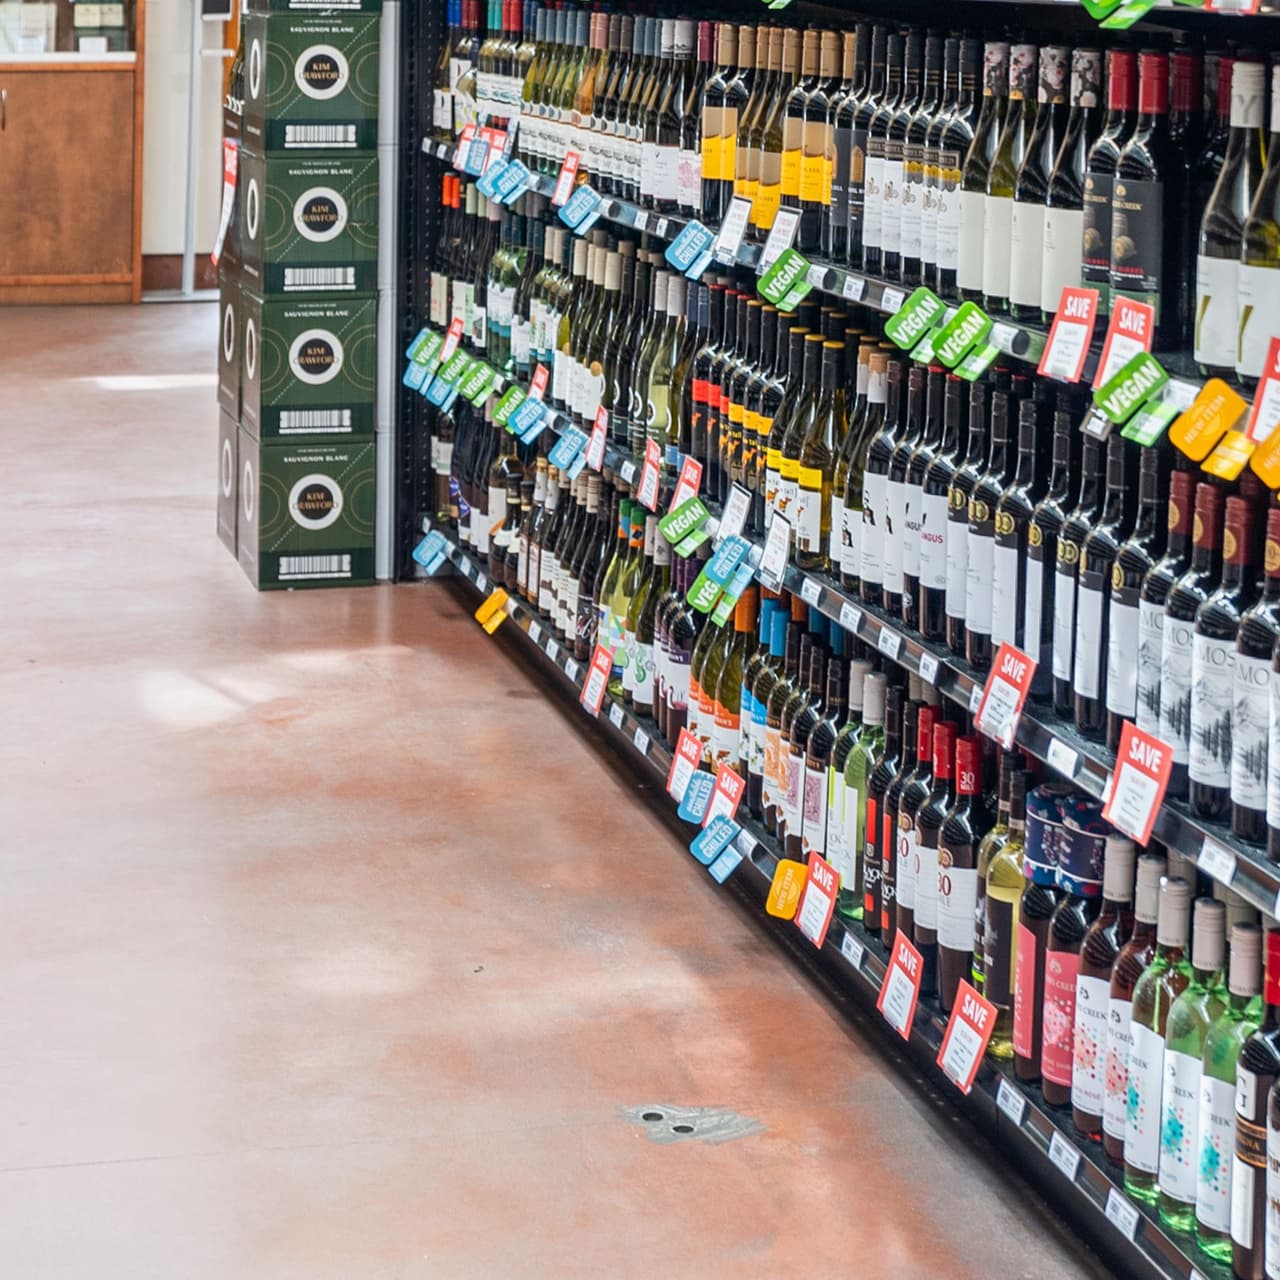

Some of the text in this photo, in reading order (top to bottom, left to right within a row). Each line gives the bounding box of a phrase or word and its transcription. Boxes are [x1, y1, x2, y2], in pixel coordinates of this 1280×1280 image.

[312, 63, 331, 71] KIM
[311, 205, 329, 213] KIM
[676, 232, 709, 265] CHILLED
[765, 255, 805, 299] VEGAN
[891, 295, 940, 345] VEGAN
[1064, 296, 1091, 319] SAVE
[1118, 307, 1147, 337] SAVE
[418, 335, 441, 365] VEGAN
[938, 310, 987, 362] VEGAN
[443, 353, 469, 382] VEGAN
[463, 366, 491, 397] VEGAN
[1103, 360, 1161, 414] VEGAN
[496, 390, 524, 423] VEGAN
[306, 492, 324, 500] KIM
[664, 503, 705, 539] VEGAN
[694, 581, 720, 608] VEG
[597, 650, 610, 668] SAVE
[1001, 653, 1027, 684] SAVE
[681, 736, 697, 759] SAVE
[1129, 736, 1163, 773] SAVE
[721, 773, 739, 795] SAVE
[960, 771, 975, 784] 30
[693, 779, 713, 817] CHILLED
[702, 825, 732, 859] CHILLED
[775, 868, 794, 911] NEW ITEM
[813, 862, 834, 892] SAVE
[898, 943, 917, 977] SAVE
[961, 993, 987, 1029] SAVE
